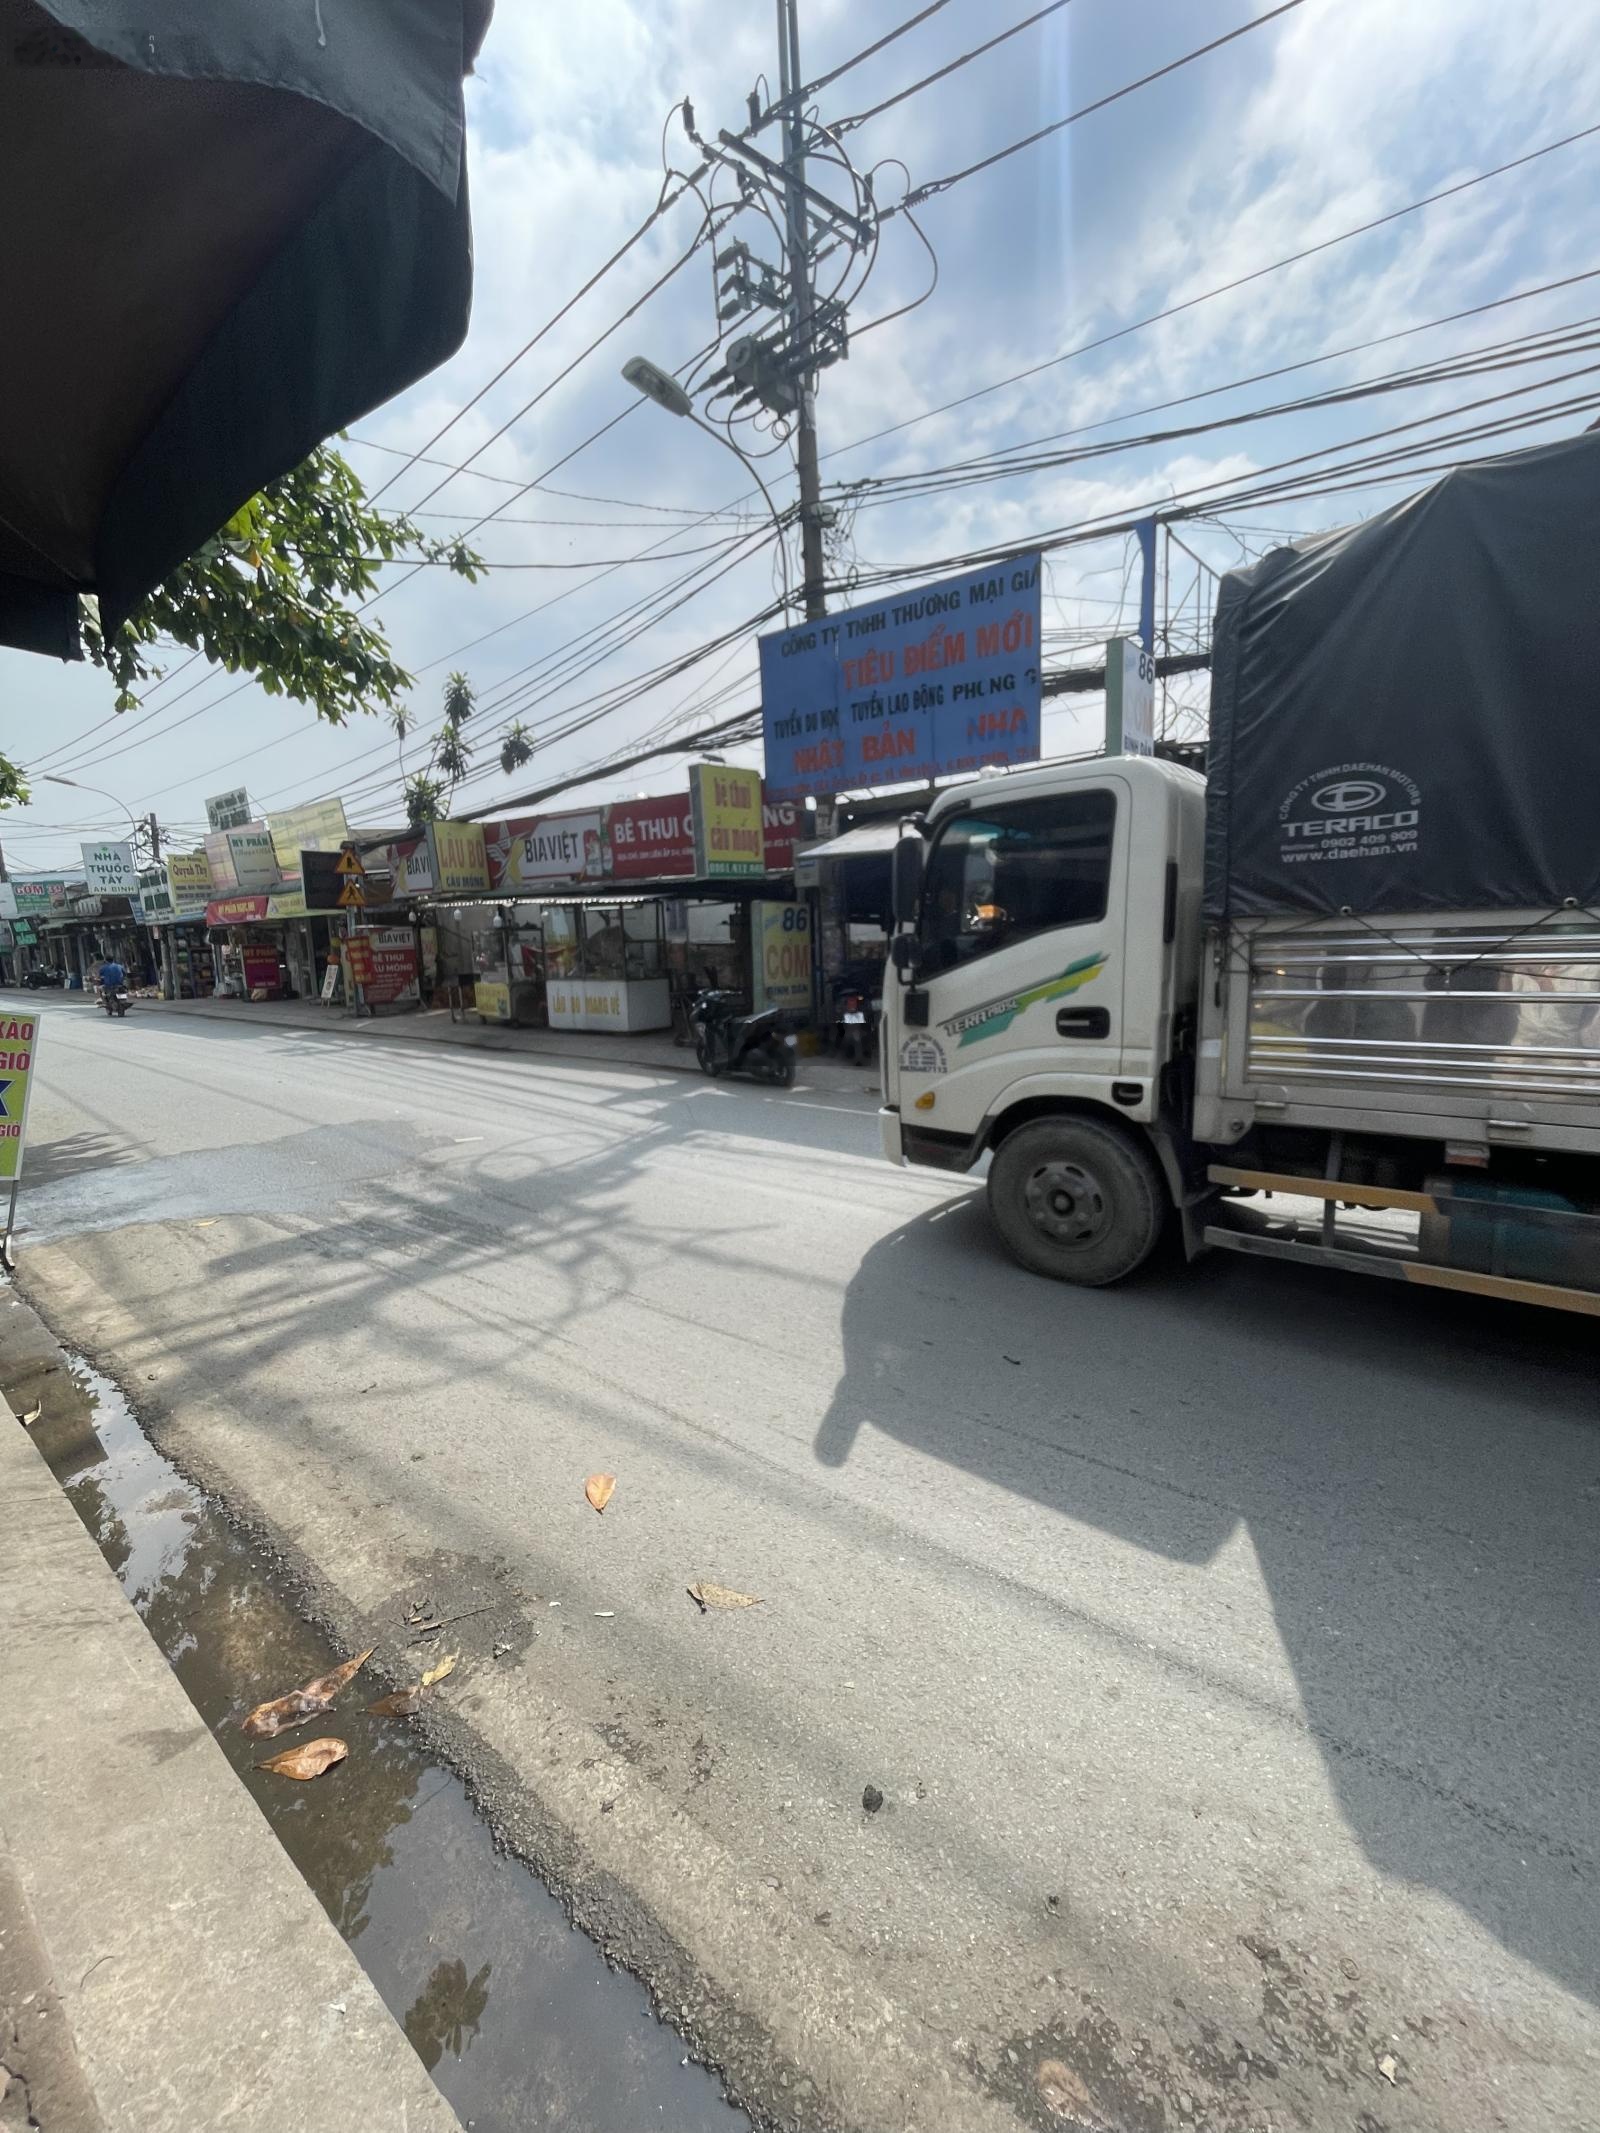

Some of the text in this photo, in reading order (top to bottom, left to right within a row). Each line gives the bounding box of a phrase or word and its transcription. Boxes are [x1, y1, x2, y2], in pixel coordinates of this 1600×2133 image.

[781, 632, 816, 658] CÔNG
[821, 625, 840, 645] TY
[846, 611, 886, 639] TNHH
[892, 593, 961, 626] THƯƠNG
[969, 577, 1004, 605] MẠI
[842, 608, 1034, 690] TIÊU ĐIỂM MỚI
[1139, 653, 1154, 685] 86
[851, 689, 884, 723] TUYỂN
[888, 692, 910, 716] LAO
[913, 683, 945, 714] ĐỘNG
[861, 720, 916, 763] BẢN
[1295, 779, 1309, 791] TY
[1342, 762, 1390, 775] DAEHAN
[1388, 769, 1421, 805] MOTORS
[615, 817, 635, 844] BÊ
[638, 816, 679, 841] THUI
[1281, 810, 1418, 837] TERACO
[1321, 837, 1356, 848] 0902
[1360, 834, 1386, 844] 409
[1390, 830, 1418, 841] 909
[1281, 842, 1417, 863] www.daehan.vn
[783, 907, 808, 931] 86
